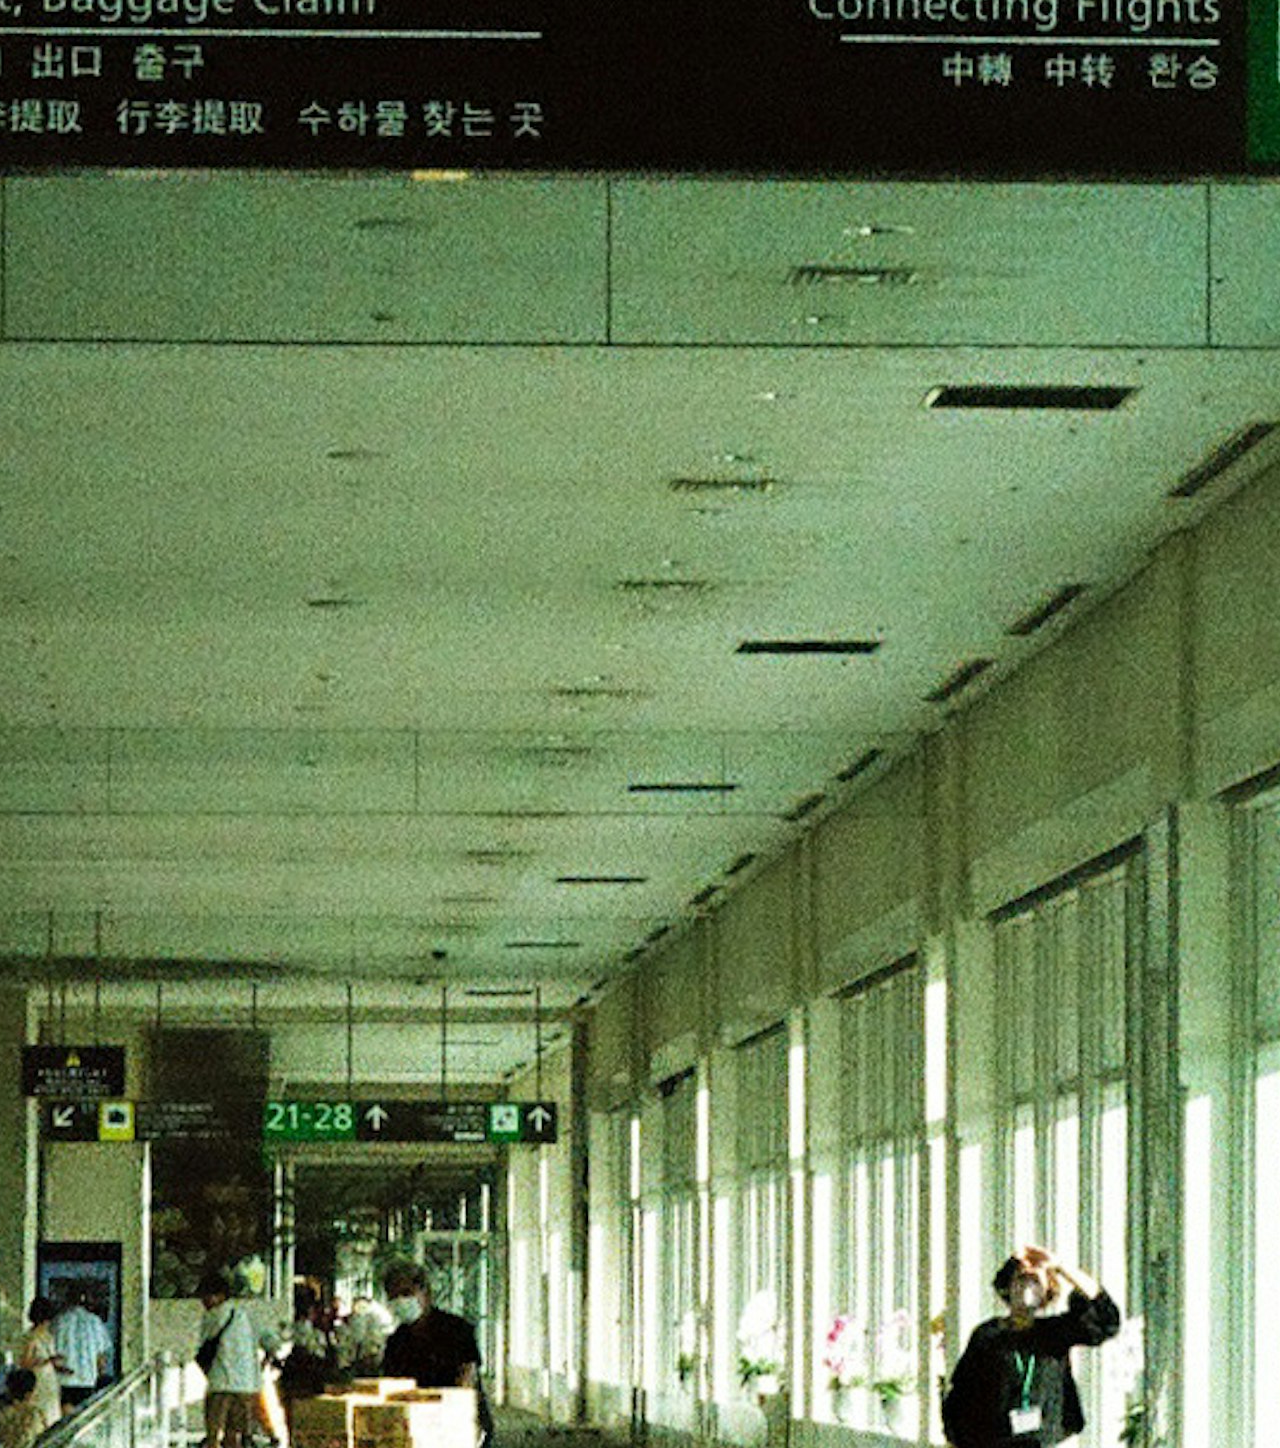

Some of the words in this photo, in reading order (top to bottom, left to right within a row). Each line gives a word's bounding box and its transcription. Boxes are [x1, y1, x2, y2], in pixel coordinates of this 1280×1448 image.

[31, 42, 103, 80] 出口
[132, 42, 205, 82] 출구
[1044, 52, 1115, 89] 中转
[116, 99, 264, 137] 行李提取
[297, 99, 409, 139] 수하물
[422, 99, 495, 138] 찾는
[510, 101, 545, 140] 곳
[267, 1103, 353, 1131] 21-28
